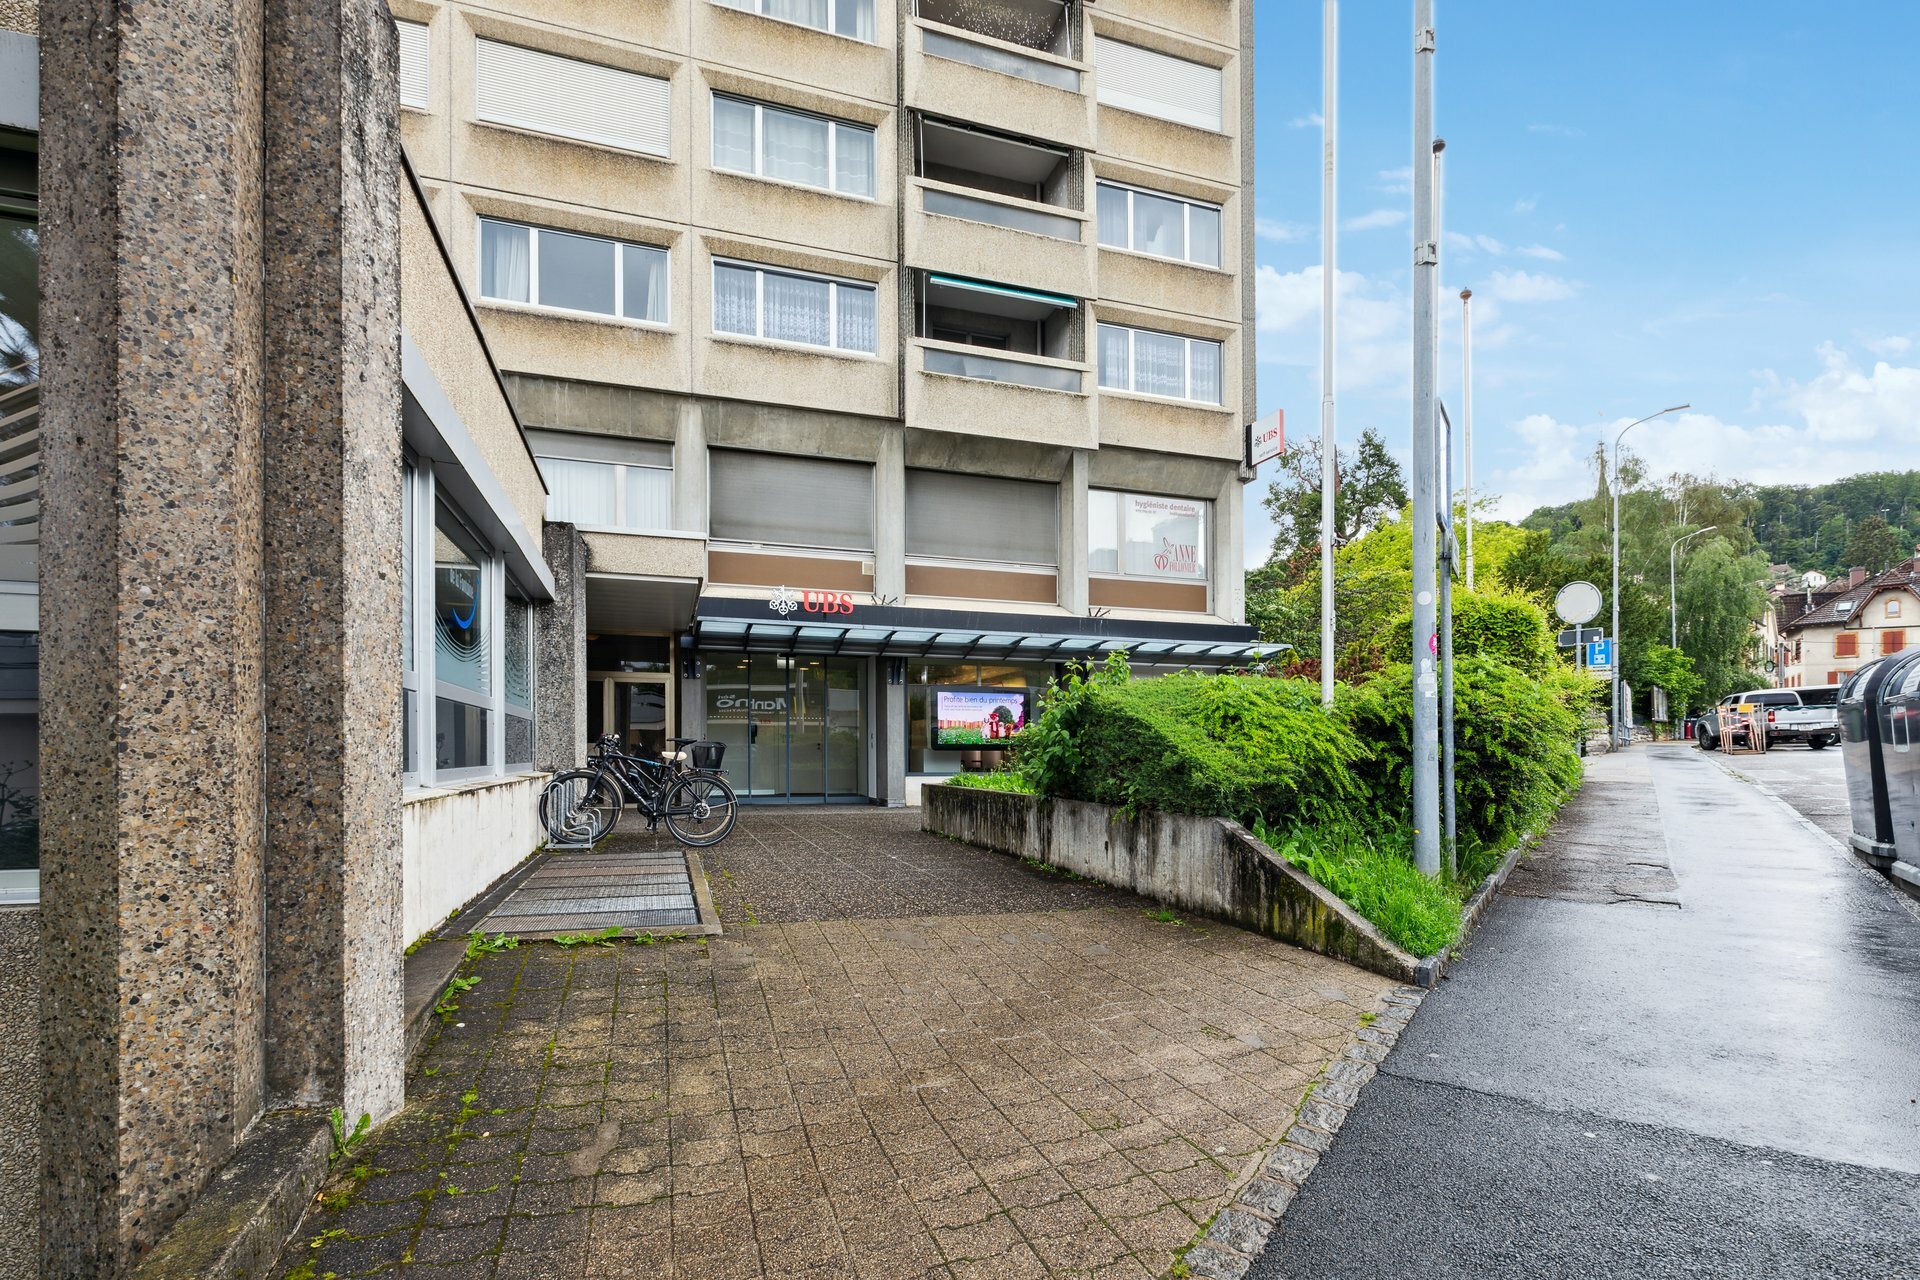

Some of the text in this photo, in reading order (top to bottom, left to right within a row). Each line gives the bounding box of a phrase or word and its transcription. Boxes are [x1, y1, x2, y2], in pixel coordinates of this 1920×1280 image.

[1263, 428, 1278, 442] UBS
[1169, 504, 1195, 512] dentaire
[1172, 544, 1196, 562] ANNE
[802, 590, 854, 614] UBS
[988, 697, 1018, 705] printemps
